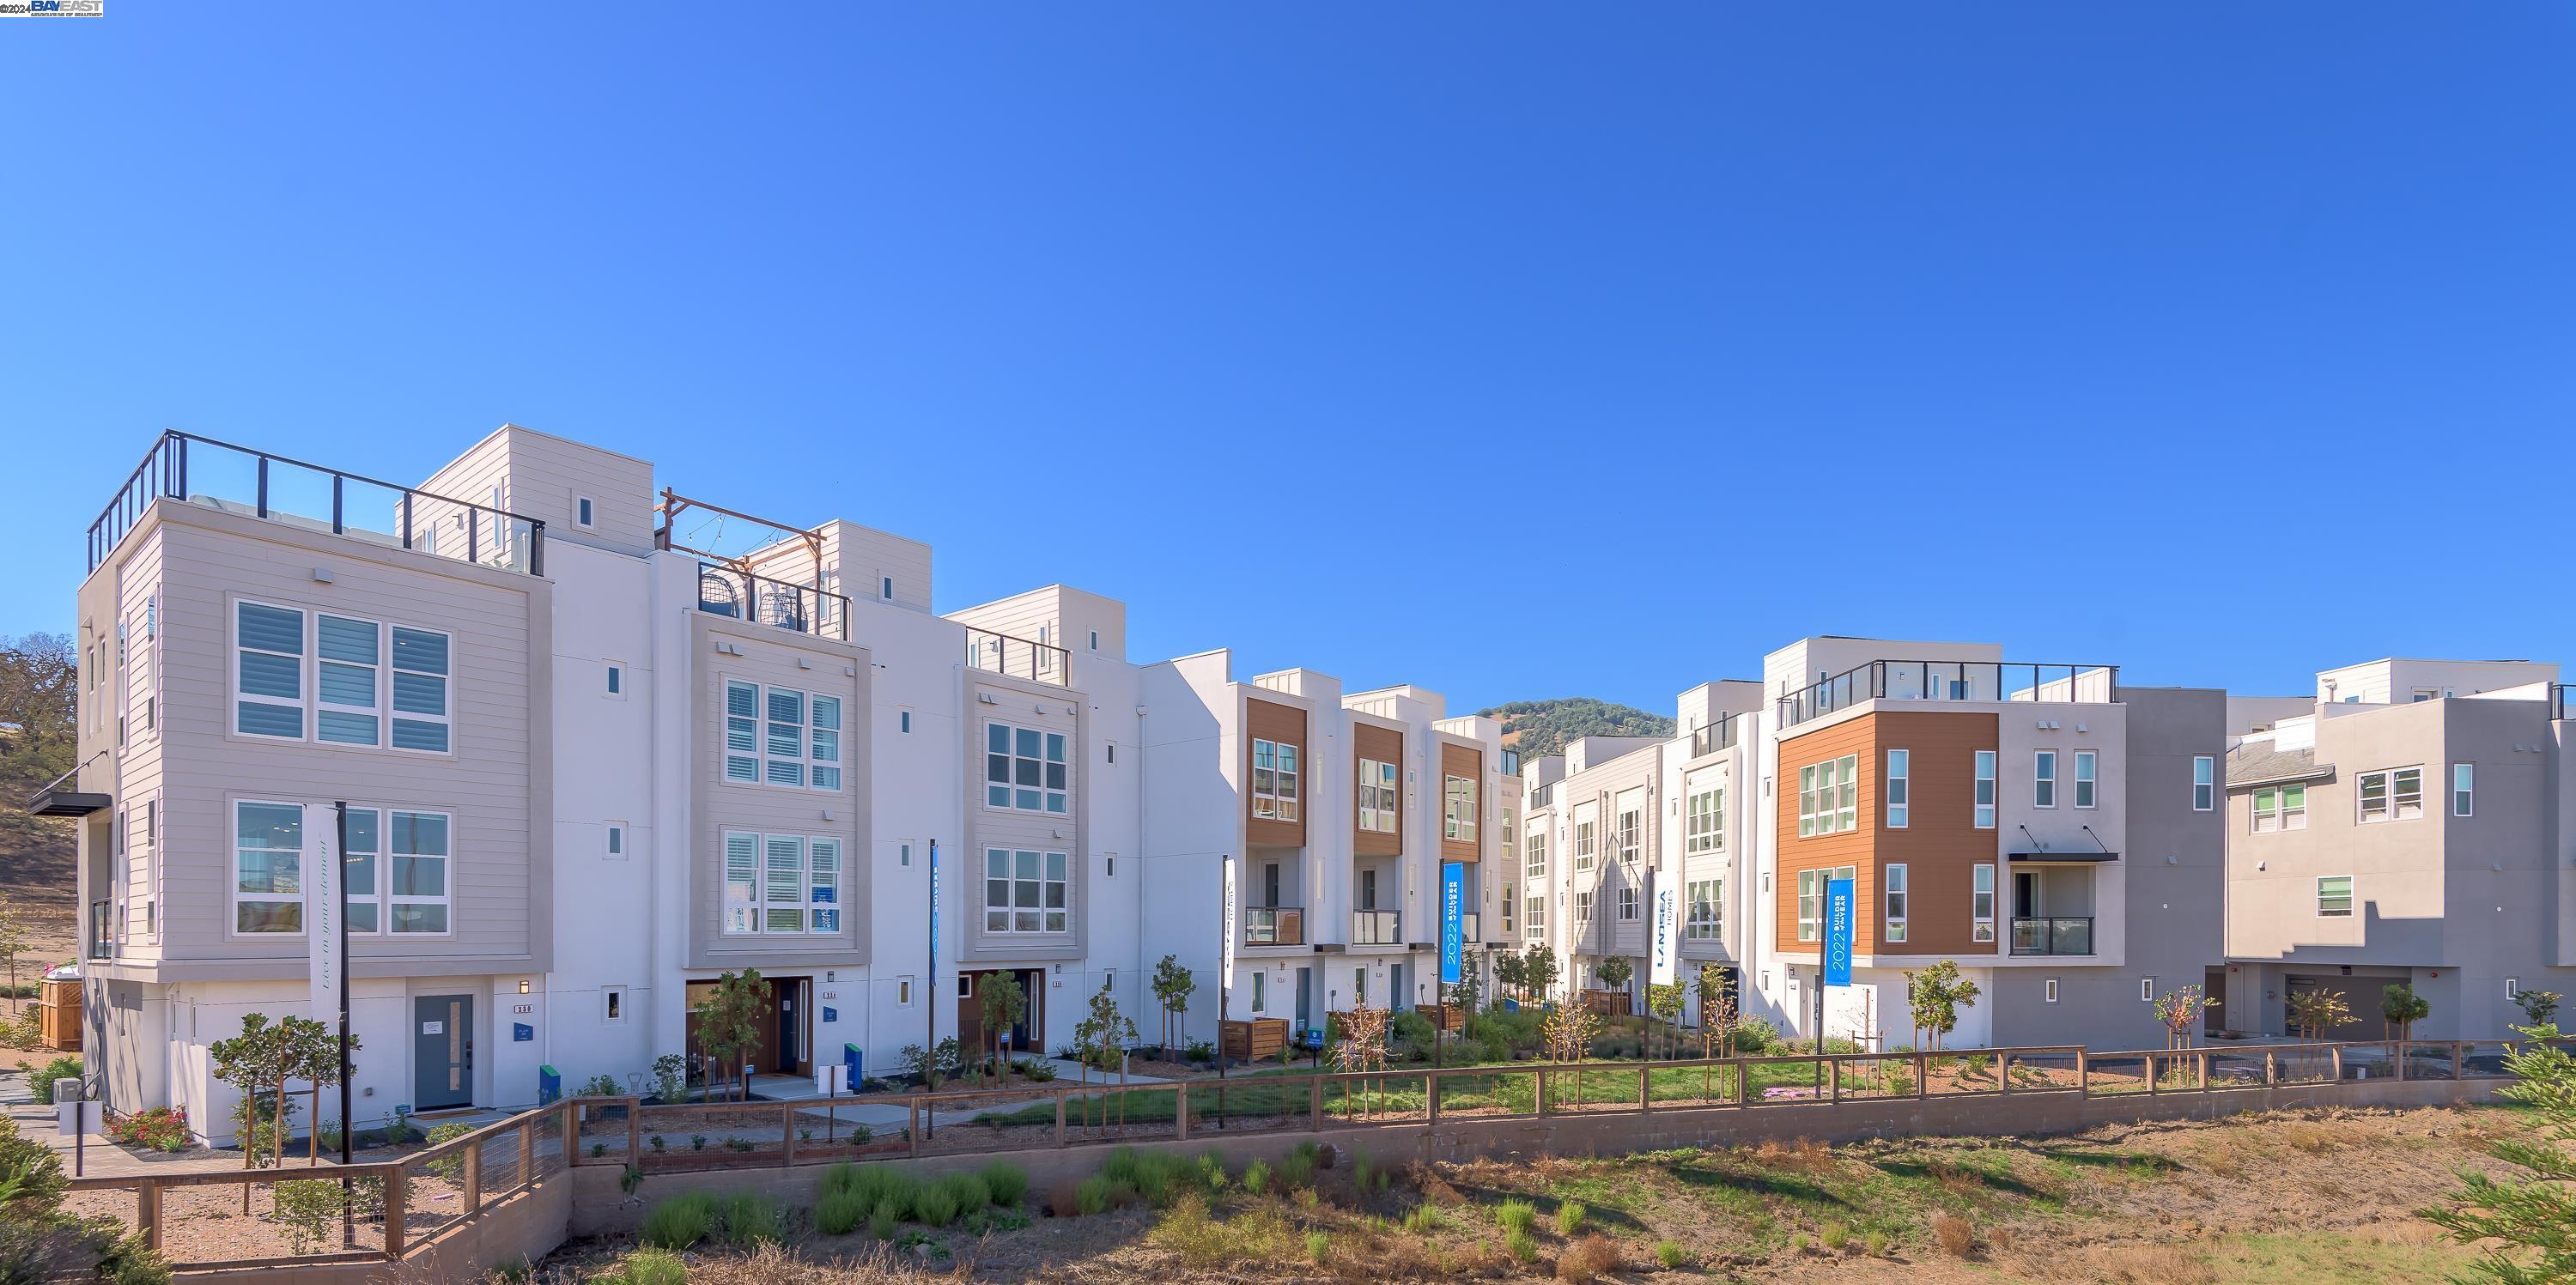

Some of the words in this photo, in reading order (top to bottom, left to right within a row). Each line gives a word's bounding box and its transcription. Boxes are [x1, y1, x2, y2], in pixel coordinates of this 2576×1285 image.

[320, 839, 329, 897] element
[322, 899, 331, 936] your
[1657, 891, 1666, 967] LANDSEA
[323, 939, 329, 954] in
[1447, 923, 1457, 965] 2022
[1832, 932, 1845, 971] 2022
